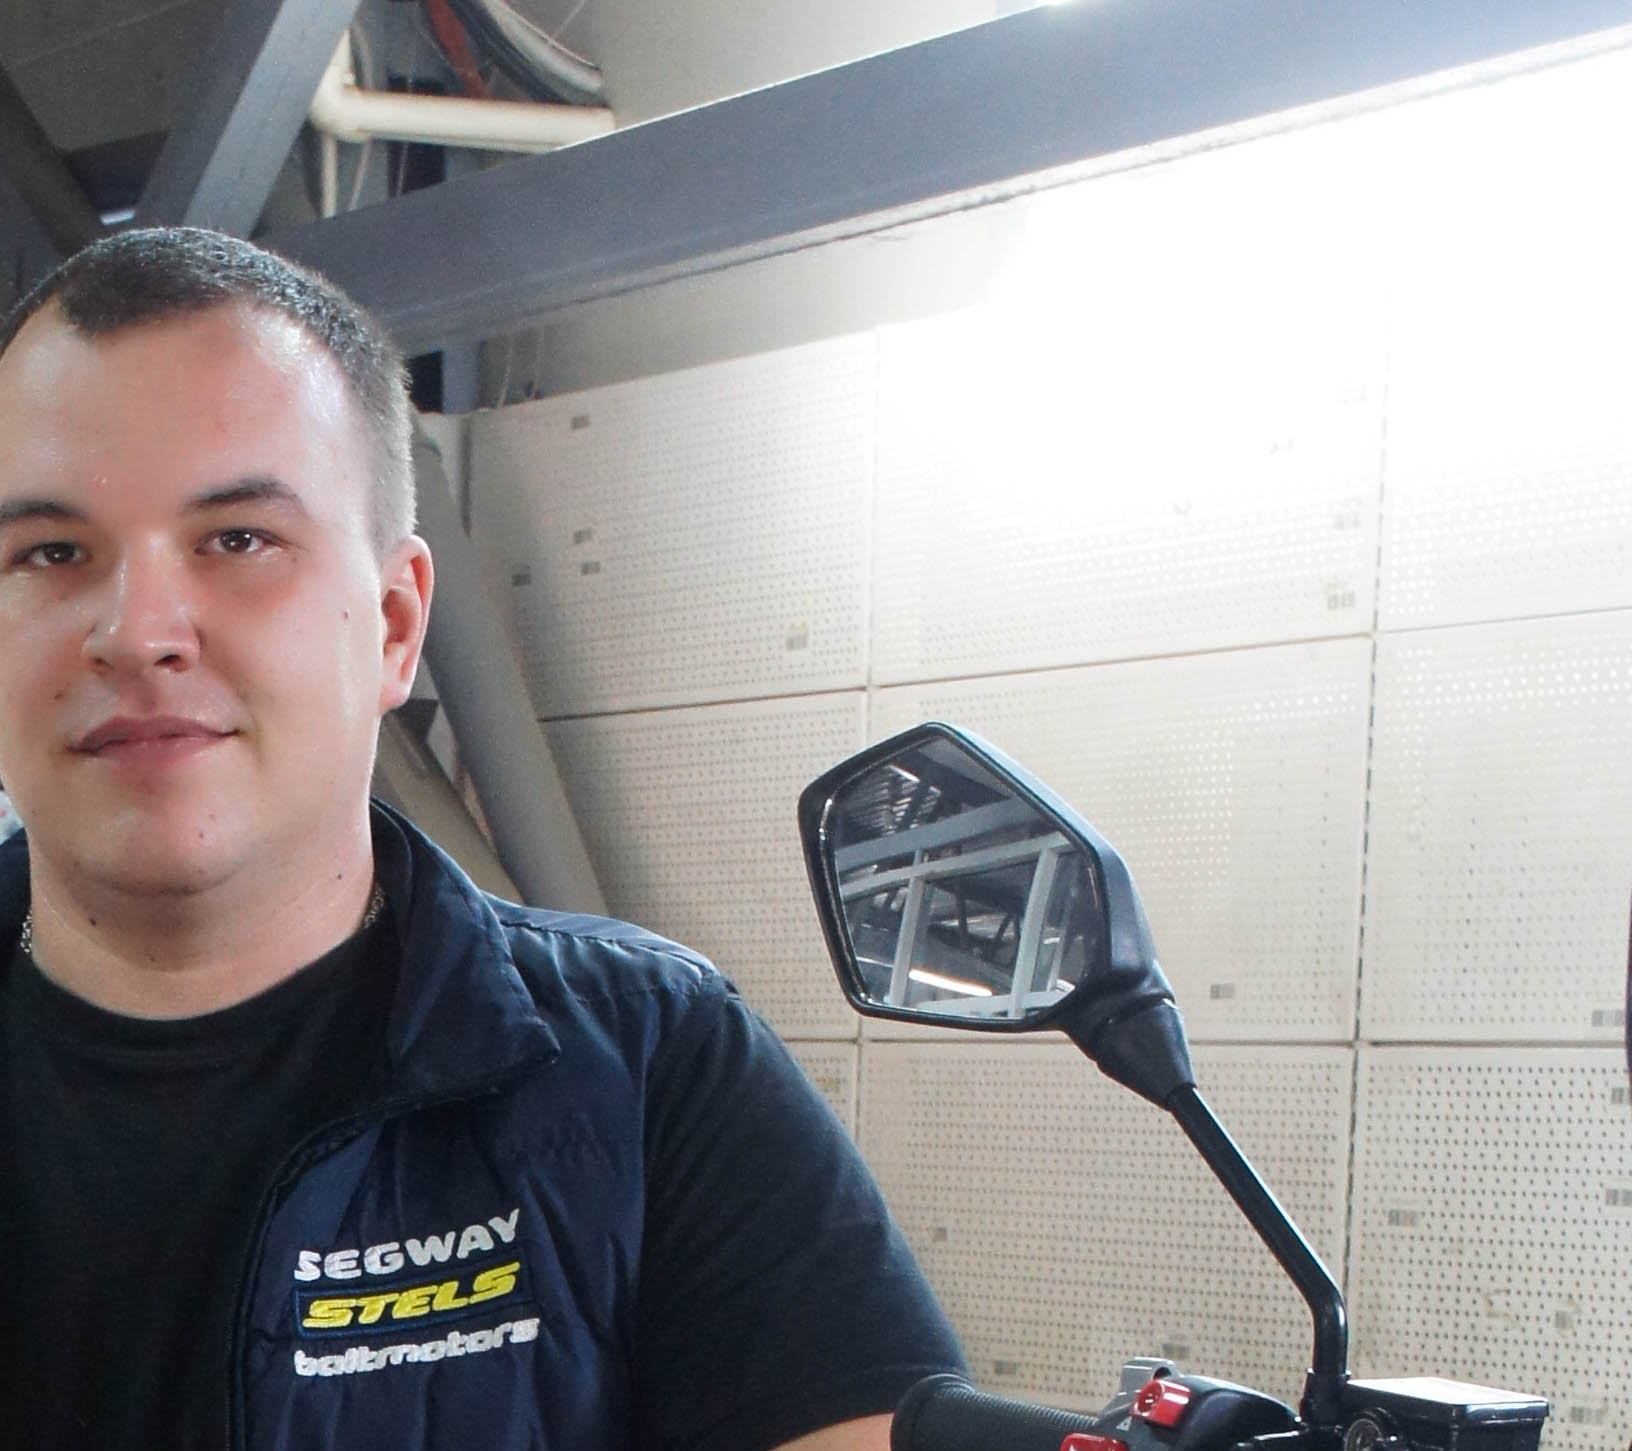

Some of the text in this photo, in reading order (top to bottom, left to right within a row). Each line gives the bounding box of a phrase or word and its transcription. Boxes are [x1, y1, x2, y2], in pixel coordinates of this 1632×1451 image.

[294, 1208, 520, 1281] SEGWAY
[302, 1261, 520, 1328] STELS
[294, 1318, 540, 1377] baltmotors
